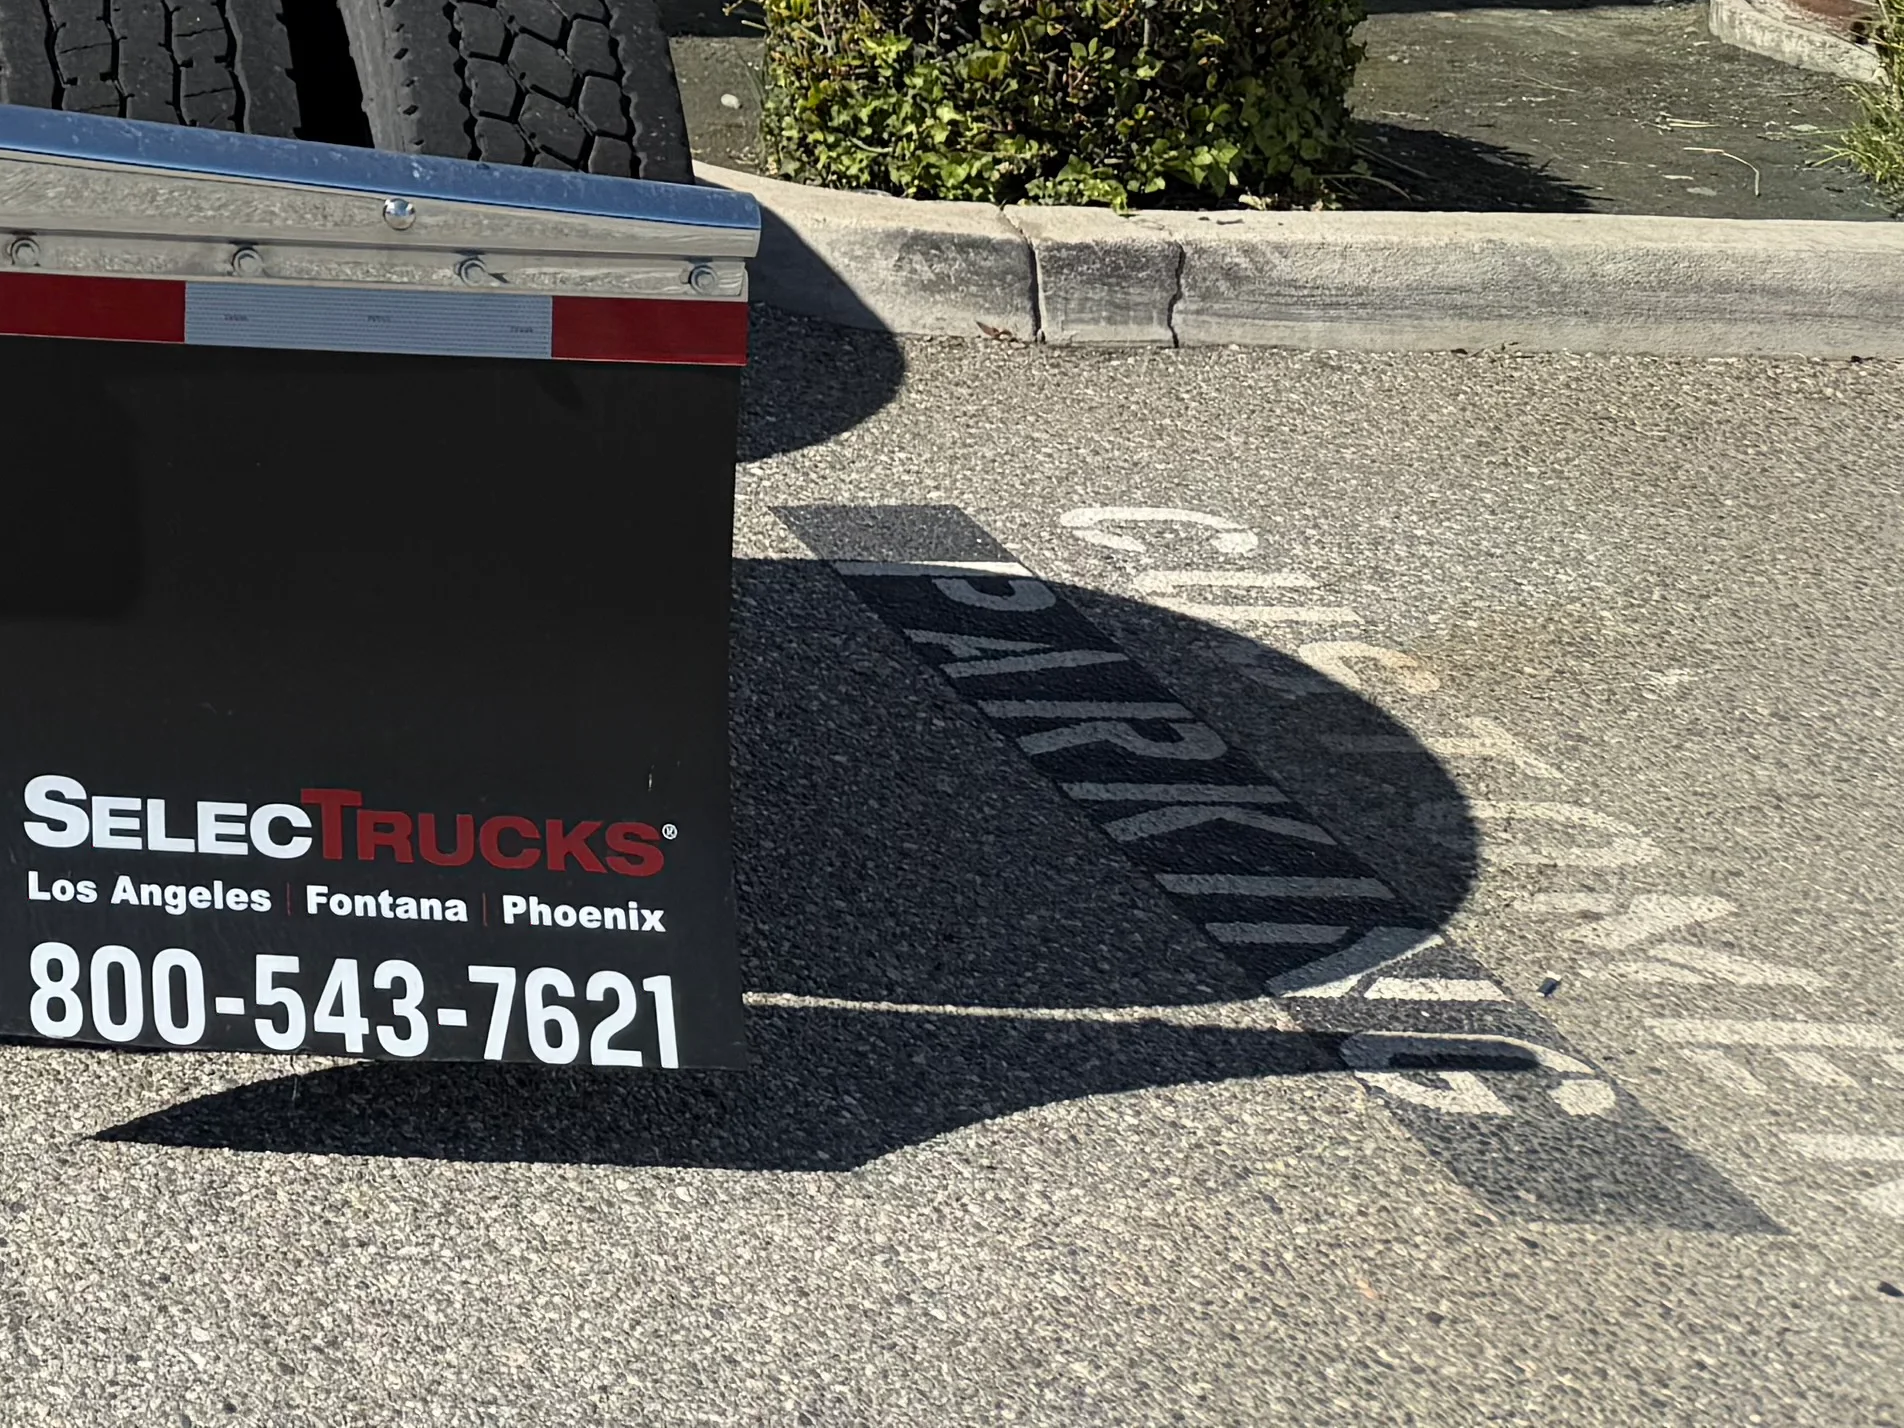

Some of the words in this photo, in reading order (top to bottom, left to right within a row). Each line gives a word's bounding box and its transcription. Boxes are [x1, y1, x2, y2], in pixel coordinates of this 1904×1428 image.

[27, 870, 98, 904] Los
[111, 875, 272, 915] Angeles
[305, 884, 469, 923] Fontana
[502, 894, 666, 933] Phoenix
[839, 561, 1617, 1116] PARKING
[28, 941, 680, 1070] 800-543-7621
